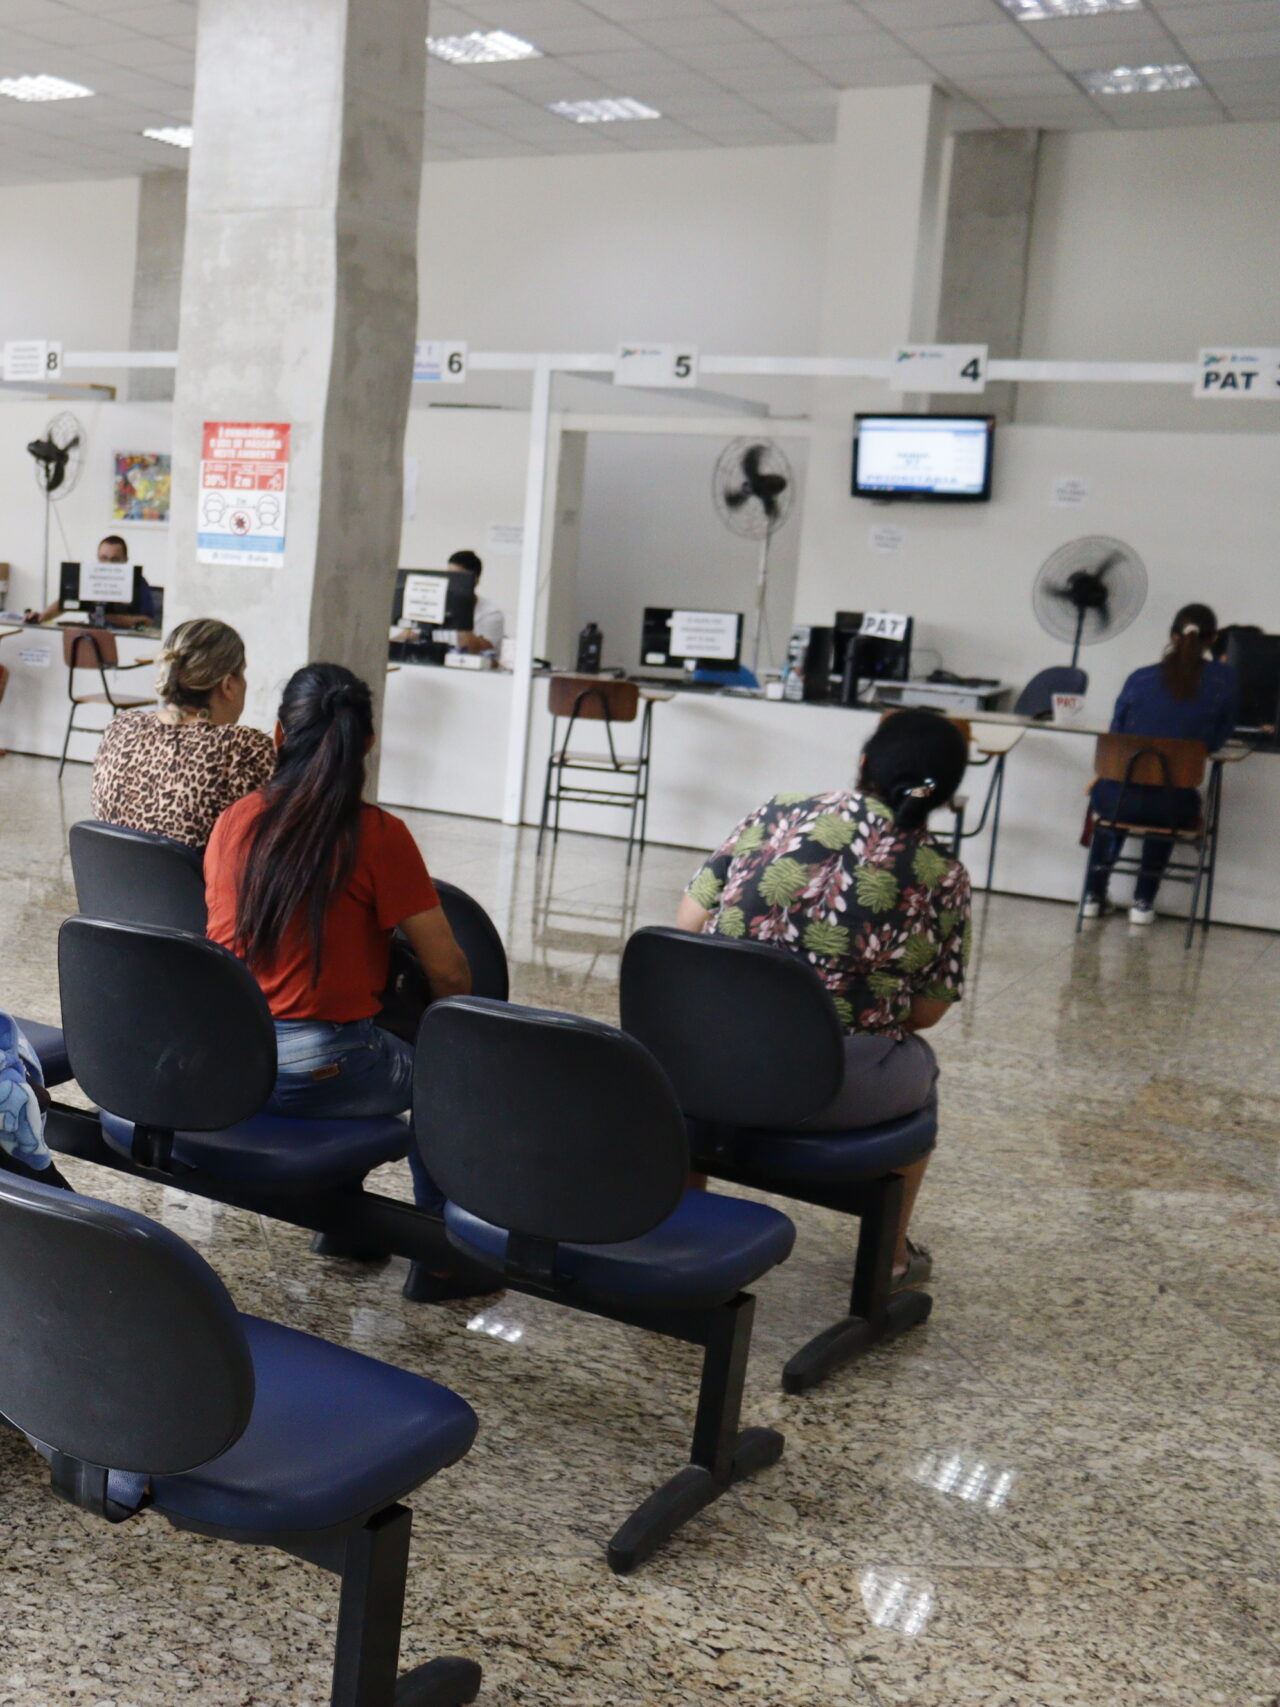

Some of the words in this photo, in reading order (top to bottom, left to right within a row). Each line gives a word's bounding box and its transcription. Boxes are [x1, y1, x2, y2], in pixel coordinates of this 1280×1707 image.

[47, 351, 58, 371] 8
[448, 351, 463, 374] 6
[674, 354, 691, 379] 5
[960, 357, 980, 382] 4
[1203, 371, 1259, 391] PAT
[864, 616, 904, 635] PAT
